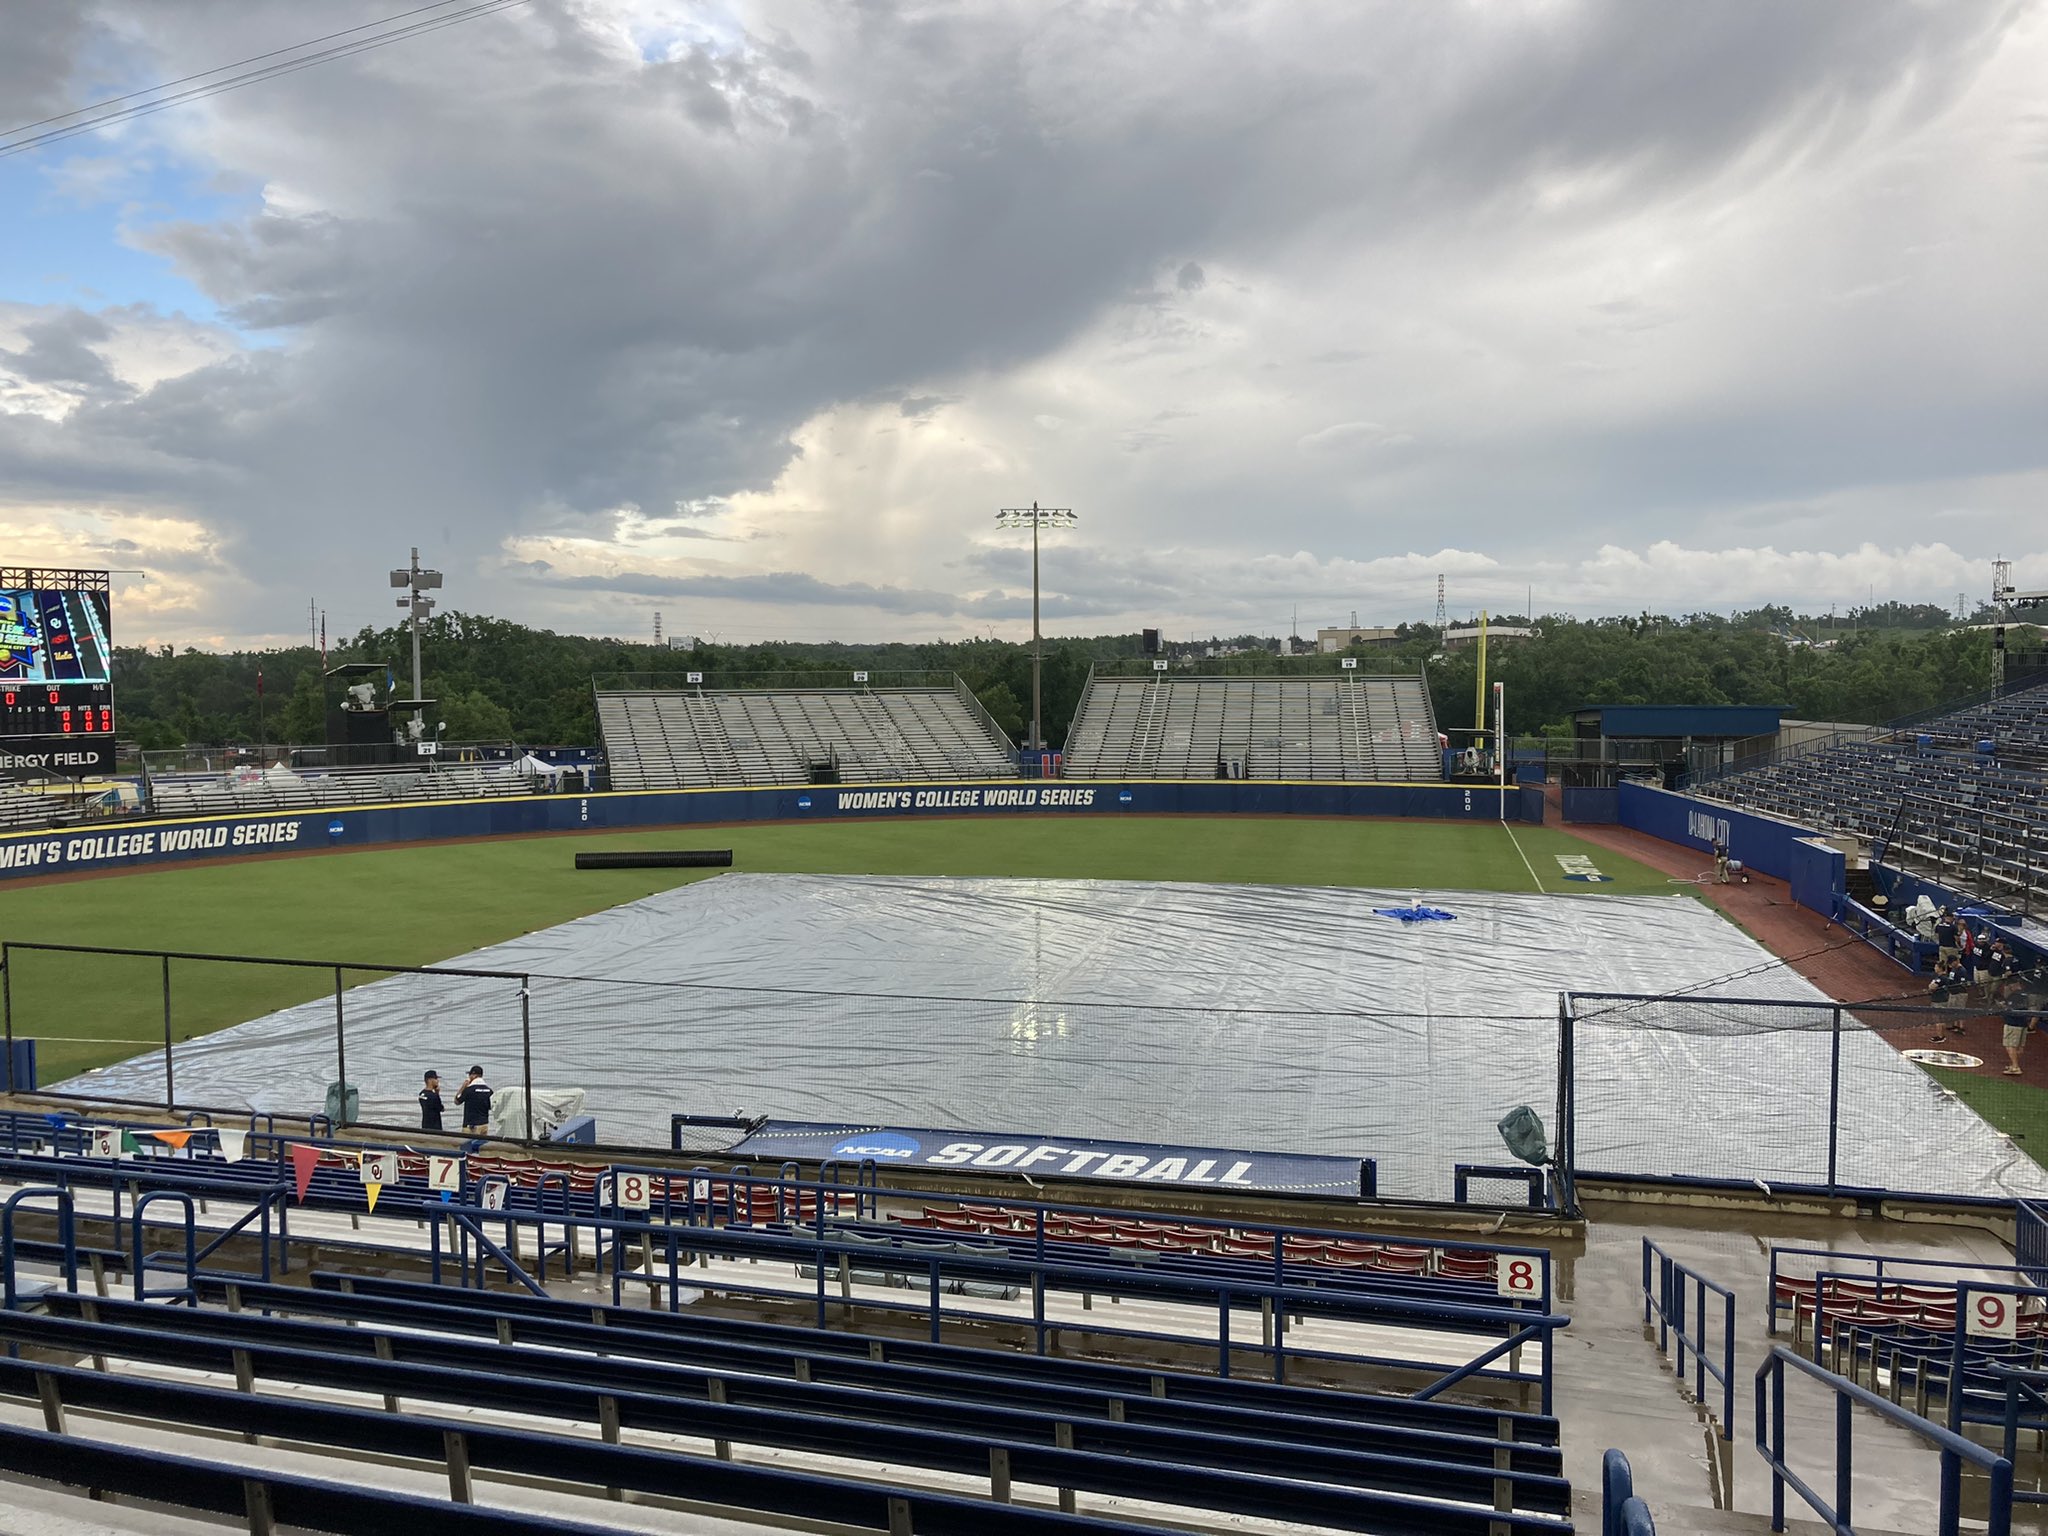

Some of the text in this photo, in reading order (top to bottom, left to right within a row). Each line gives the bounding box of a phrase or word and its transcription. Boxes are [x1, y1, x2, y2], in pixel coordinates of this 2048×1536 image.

[6, 692, 58, 705] 0 0
[63, 710, 109, 721] 0 0 0
[63, 721, 109, 732] 0 0 0
[54, 752, 99, 766] FIELD
[838, 789, 1094, 810] WOMEN'S COLLEGE WORLD SERIES
[66, 833, 156, 861] COLLEGE
[160, 826, 228, 853] WORLD
[232, 822, 299, 846] SERIES
[437, 1159, 454, 1184] 7
[836, 1142, 1253, 1186] NCAA SOFTBALL
[625, 1177, 643, 1202] 8
[1508, 1260, 1534, 1290] 8
[1977, 1296, 2006, 1329] 9
